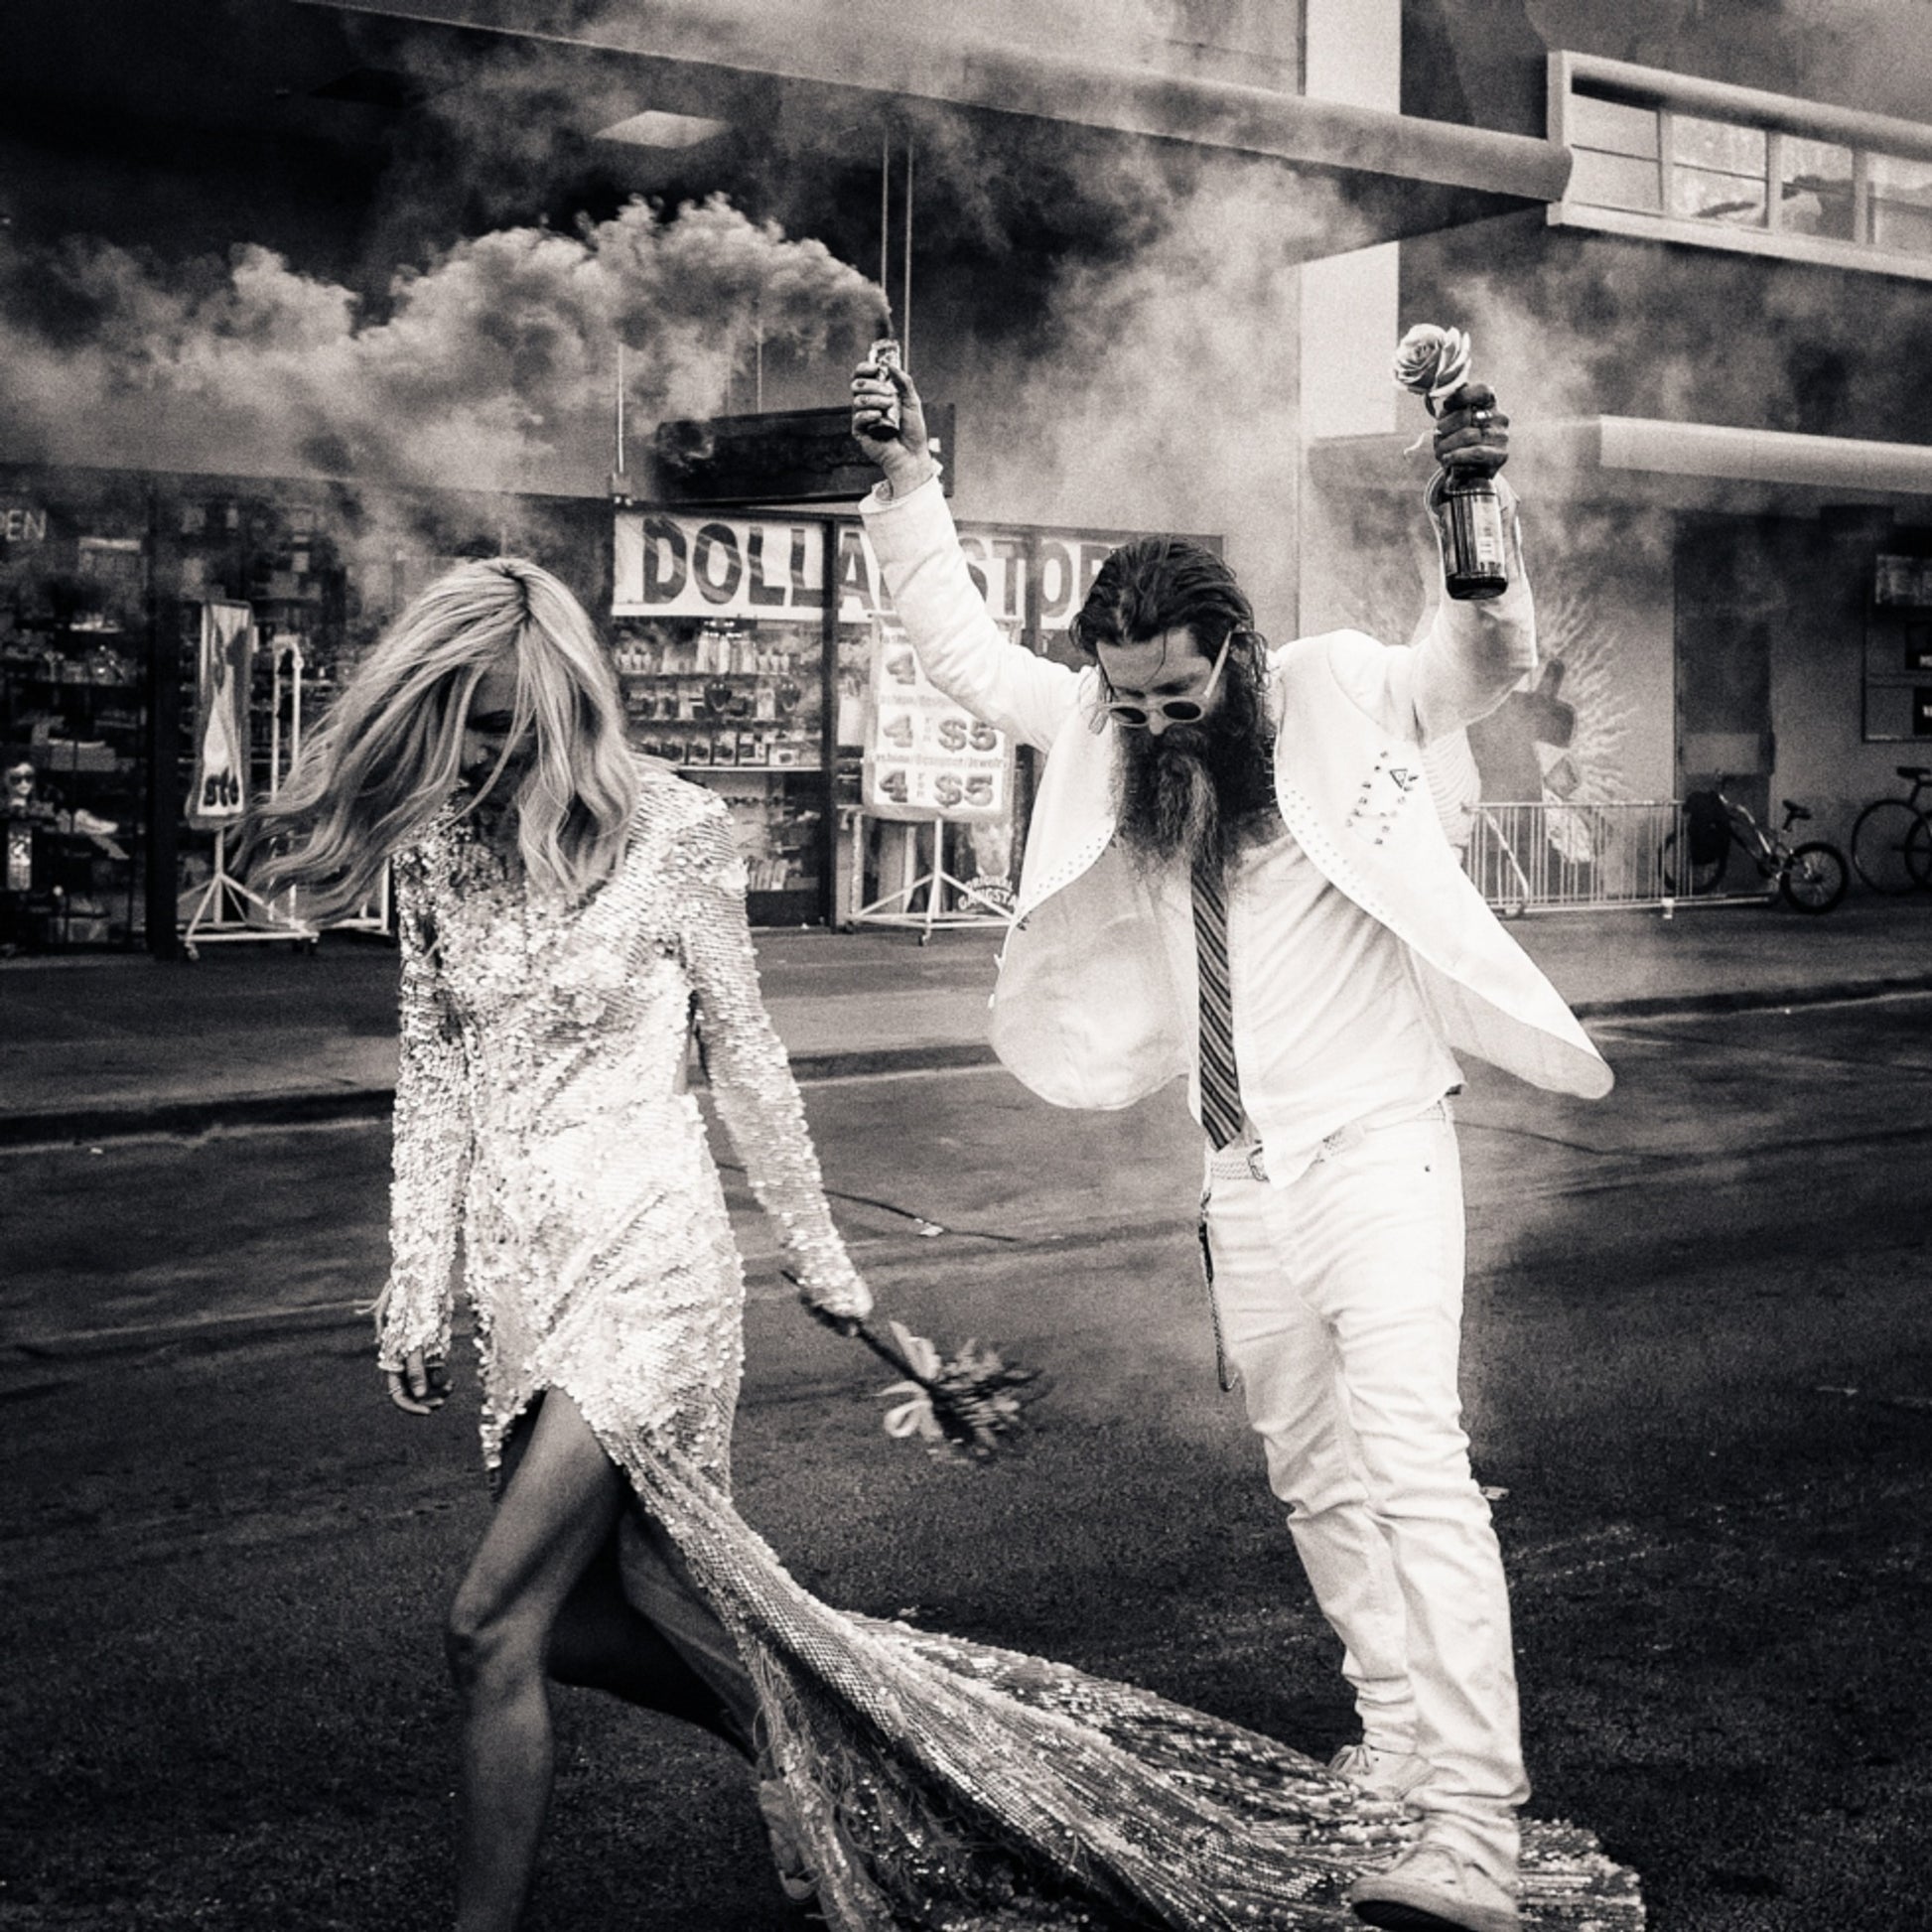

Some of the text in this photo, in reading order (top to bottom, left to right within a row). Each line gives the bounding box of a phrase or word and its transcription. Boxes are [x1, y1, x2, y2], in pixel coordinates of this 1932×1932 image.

[0, 509, 47, 541] EN
[643, 514, 894, 611] DOLLA
[885, 651, 915, 685] 4
[883, 714, 913, 749] 4
[938, 716, 997, 753] $5
[879, 769, 908, 803] 4
[933, 770, 995, 809] $5
